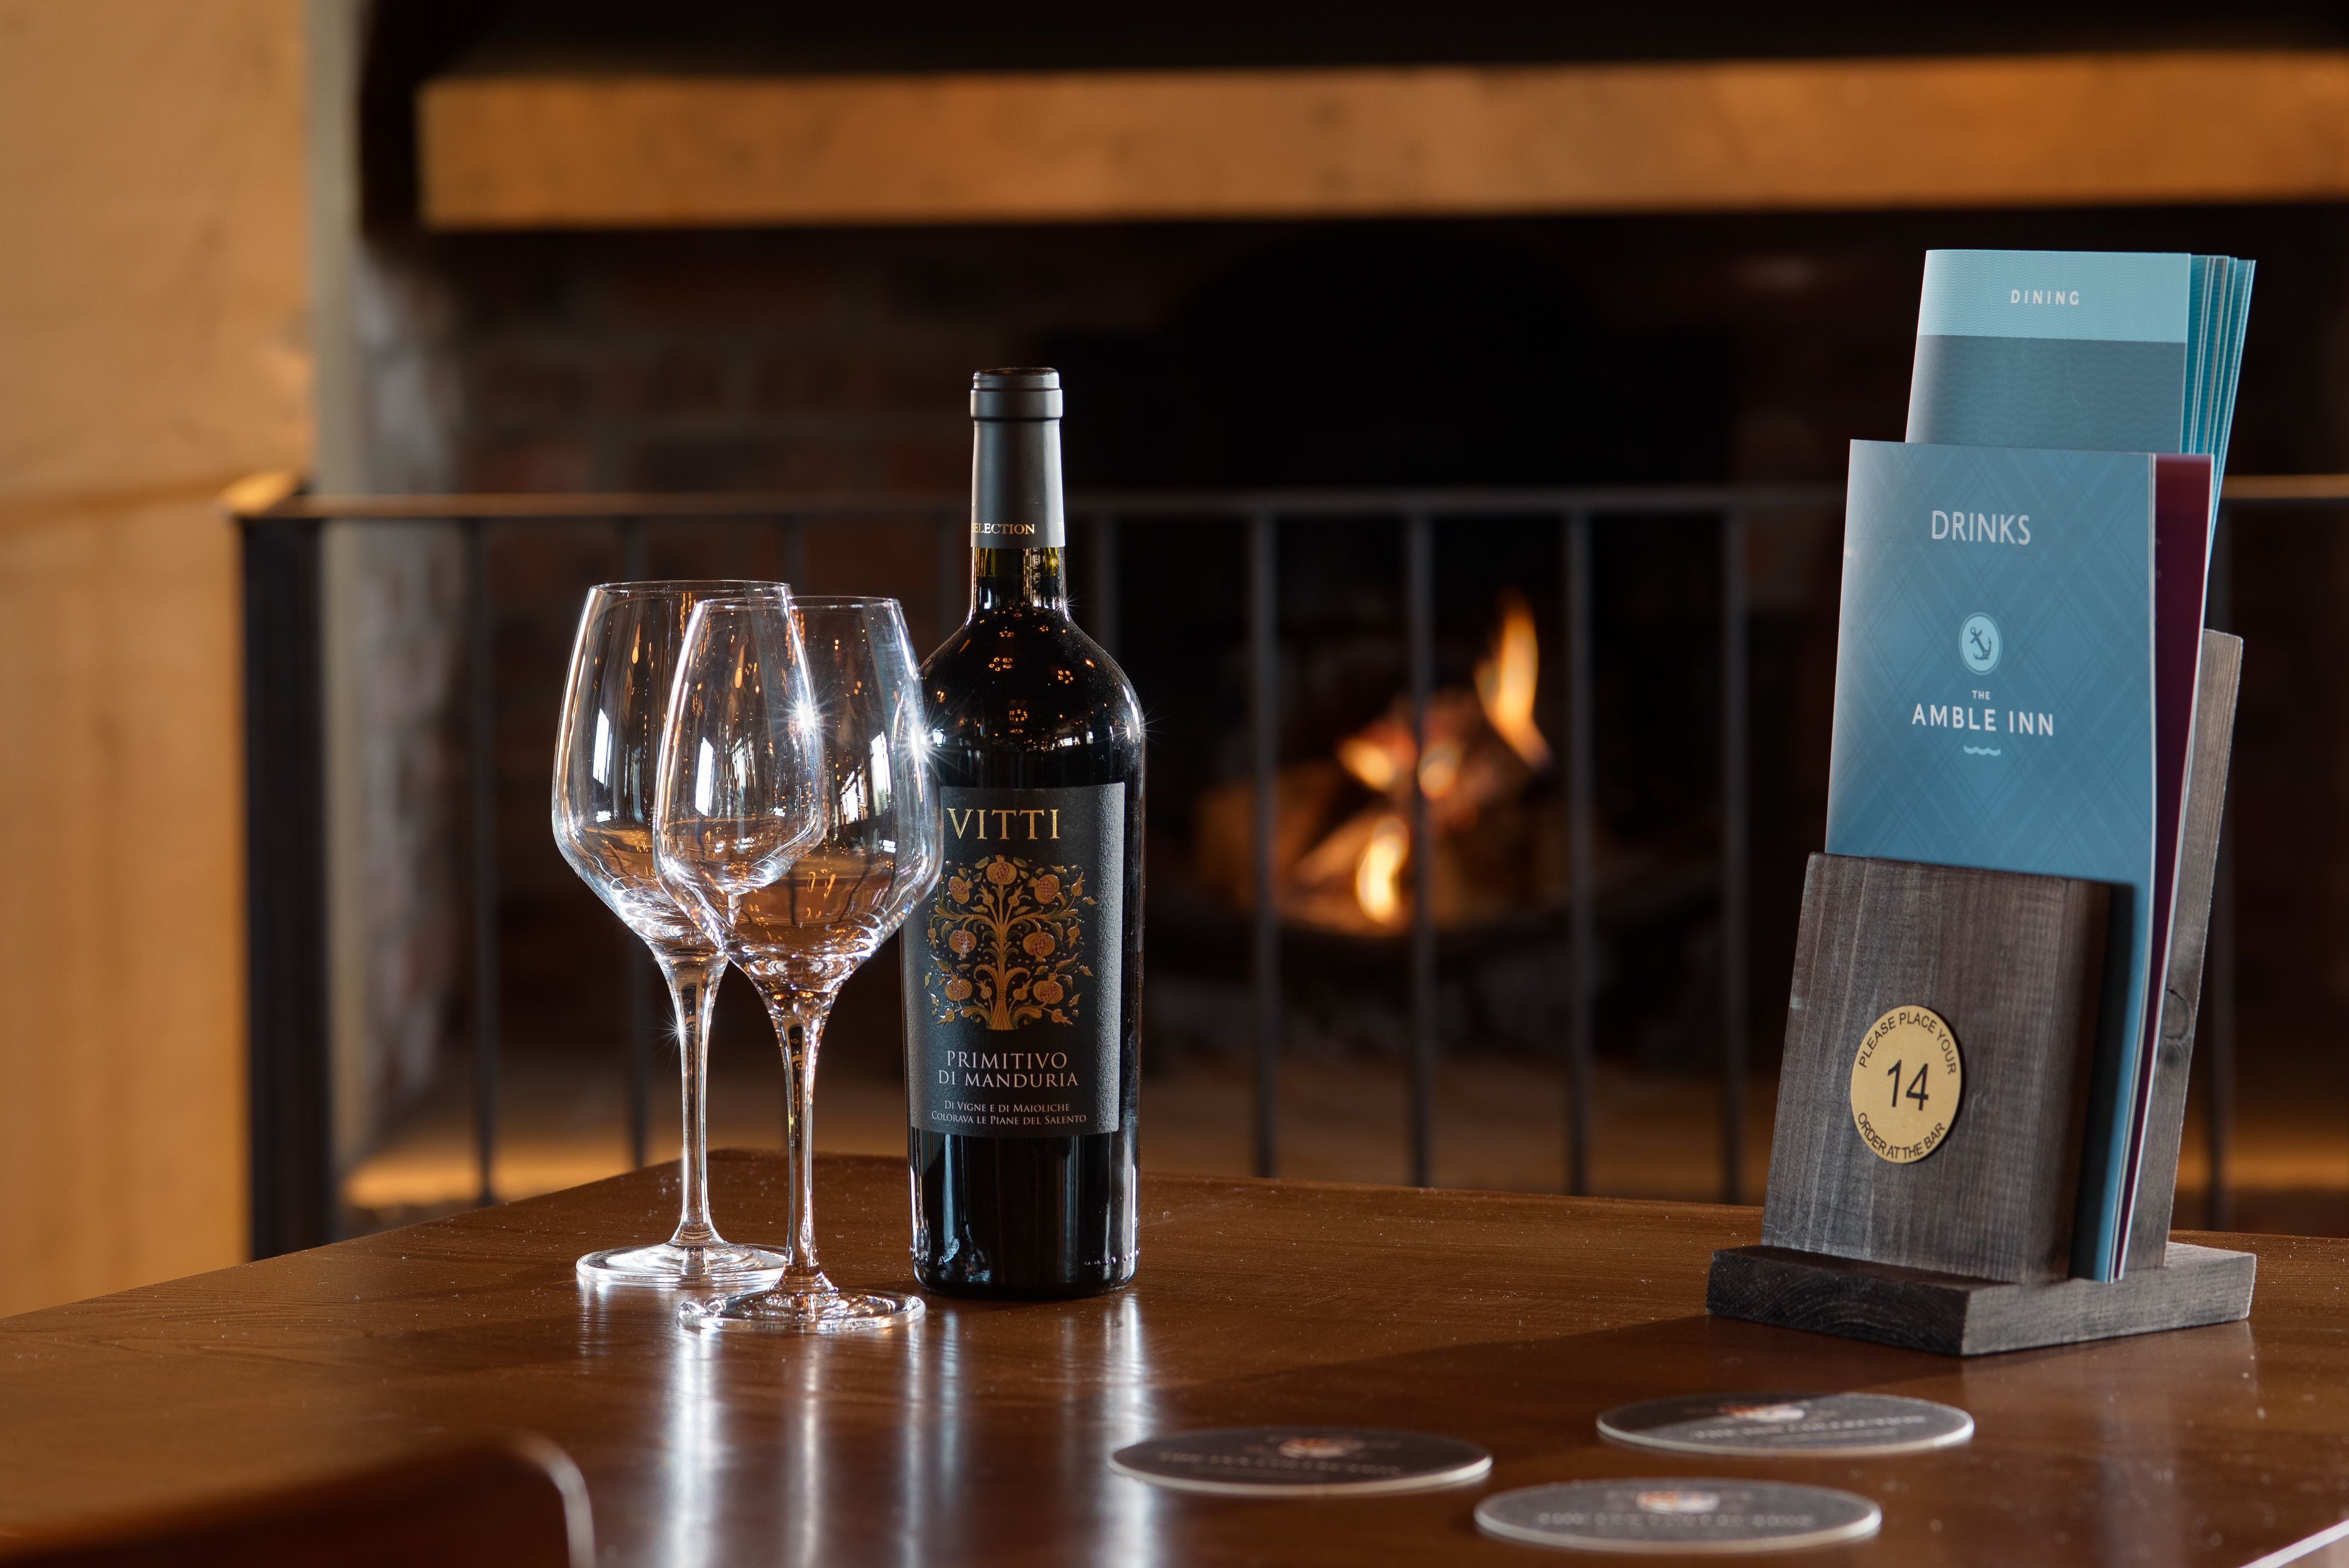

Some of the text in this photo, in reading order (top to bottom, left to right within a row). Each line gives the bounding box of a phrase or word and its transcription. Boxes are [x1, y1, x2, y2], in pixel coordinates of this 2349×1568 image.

[2011, 289, 2080, 306] DINING
[1931, 511, 2031, 545] DRINKS
[1972, 690, 1991, 700] THE
[1912, 704, 2053, 736] AMBLE INN
[947, 808, 1060, 839] VITTI
[1859, 1012, 1956, 1075] PLEASE PLACE YOUR
[947, 1051, 1067, 1070] PRIMITIVO
[938, 1070, 1079, 1088] DI MANDURIA
[1887, 1059, 1929, 1111] 14
[1858, 1113, 1946, 1160] ORDER AT THE BAR
